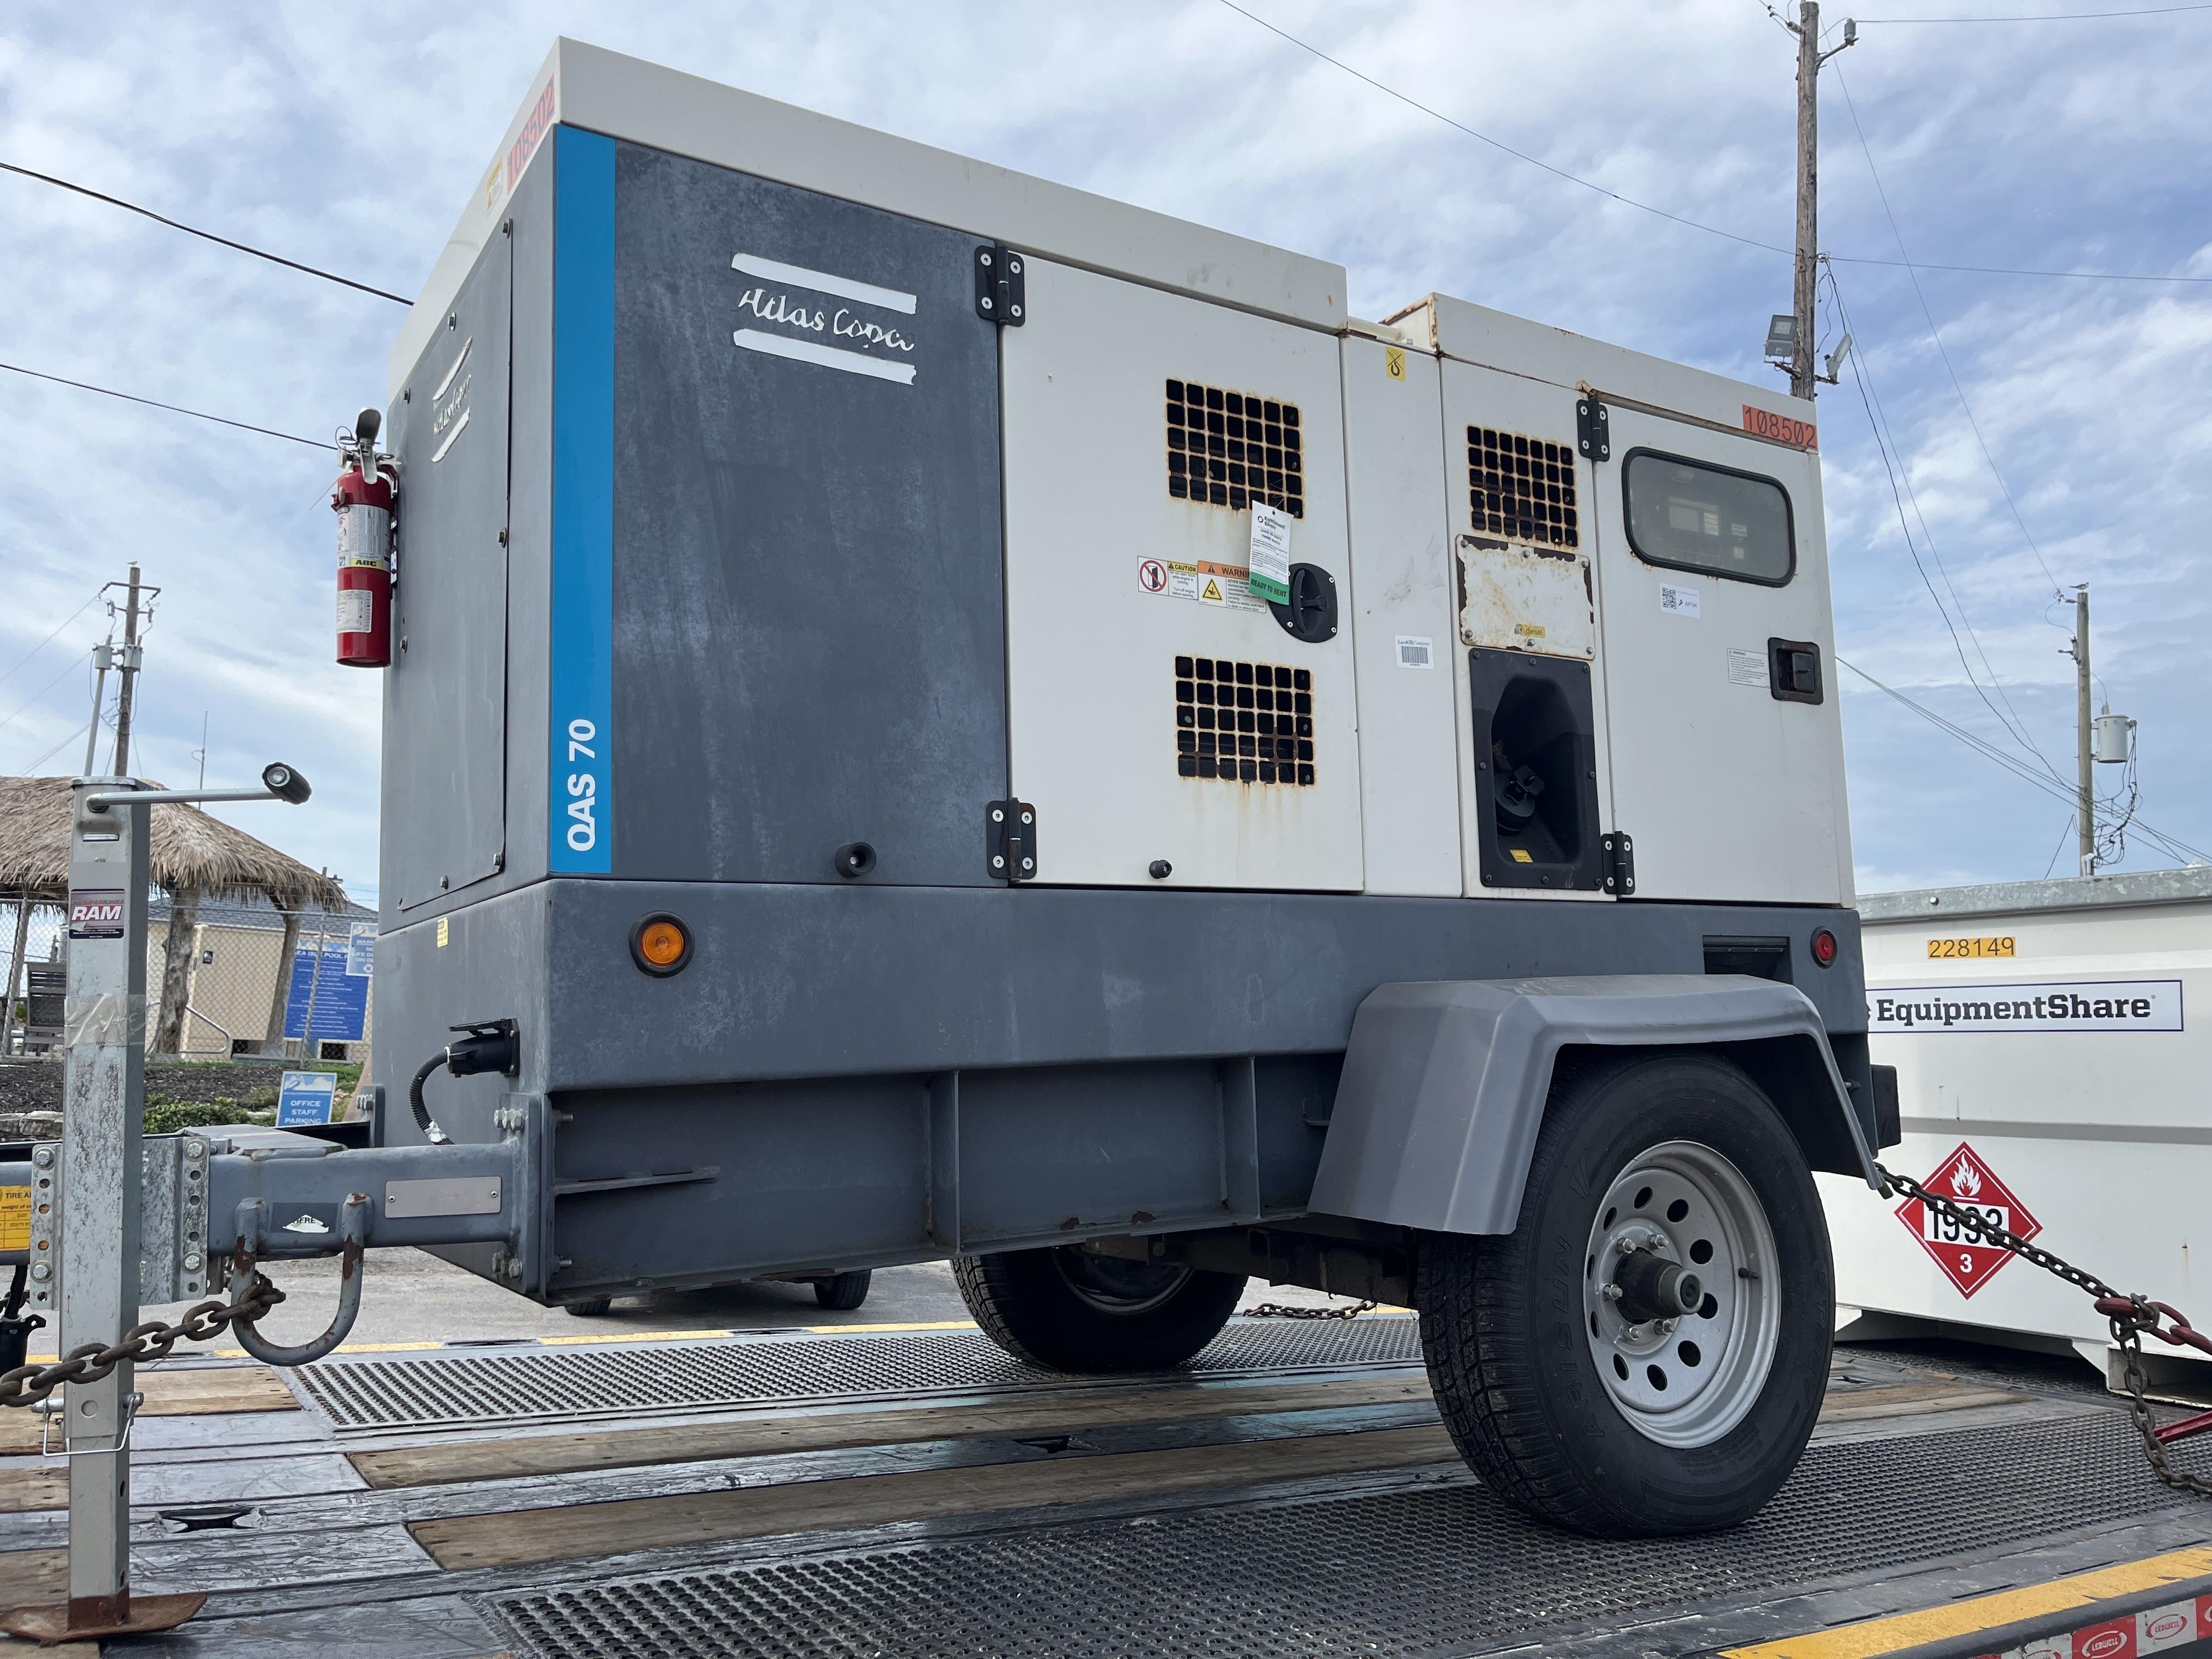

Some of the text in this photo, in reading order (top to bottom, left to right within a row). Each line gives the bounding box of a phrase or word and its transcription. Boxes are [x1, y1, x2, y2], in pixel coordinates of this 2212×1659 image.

[738, 289, 824, 331] Atlas
[1175, 564, 1196, 572] CAUTION
[1251, 579, 1287, 597] READY TO RENT
[1526, 627, 1542, 635] diesel
[567, 719, 596, 851] QAS 70
[71, 906, 122, 921] RAM
[1929, 937, 2014, 958] 228149
[1960, 1253, 1973, 1273] 3
[1553, 1234, 1606, 1437] ARISUN
[2154, 1621, 2180, 1633] LEDWELL
[2091, 1638, 2118, 1651] LEDWELL
